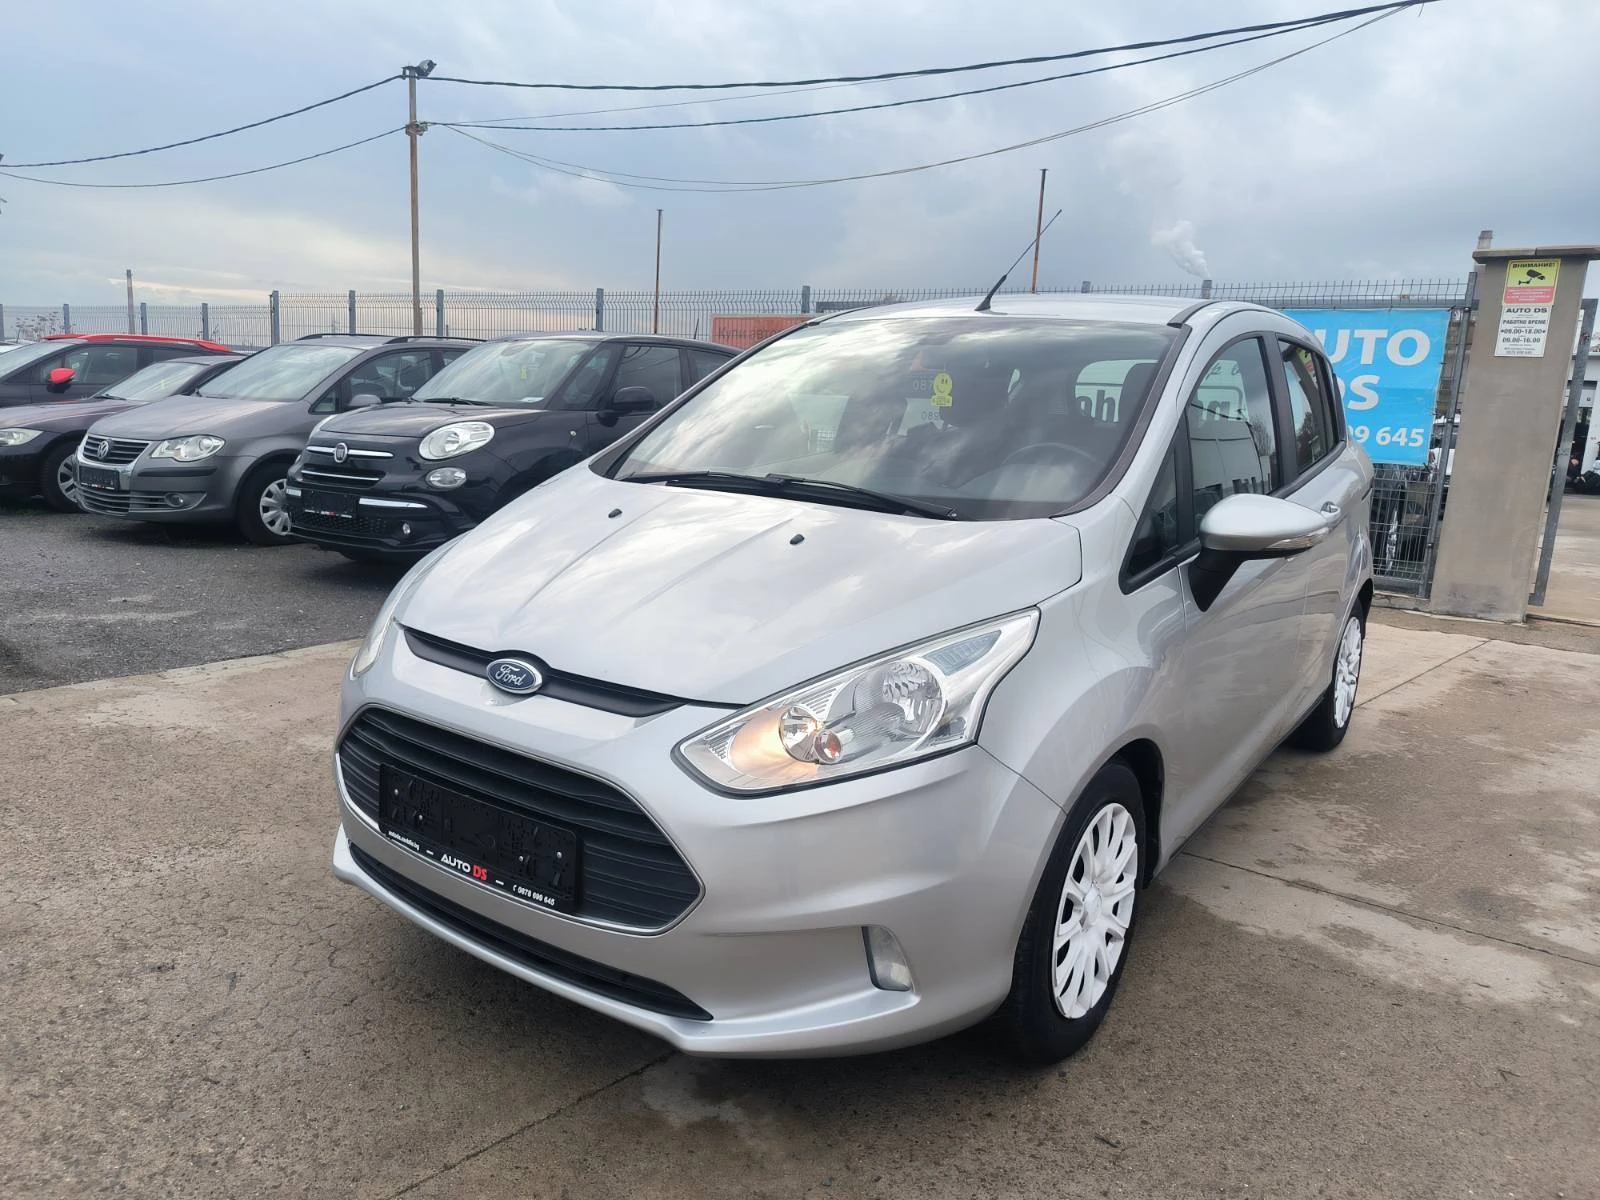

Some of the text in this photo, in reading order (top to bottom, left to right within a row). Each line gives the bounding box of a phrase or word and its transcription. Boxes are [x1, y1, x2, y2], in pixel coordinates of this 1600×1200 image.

[1336, 374, 1380, 411] S
[1375, 426, 1425, 448] 645
[495, 663, 527, 686] Ford
[440, 853, 488, 881] AUTO DS
